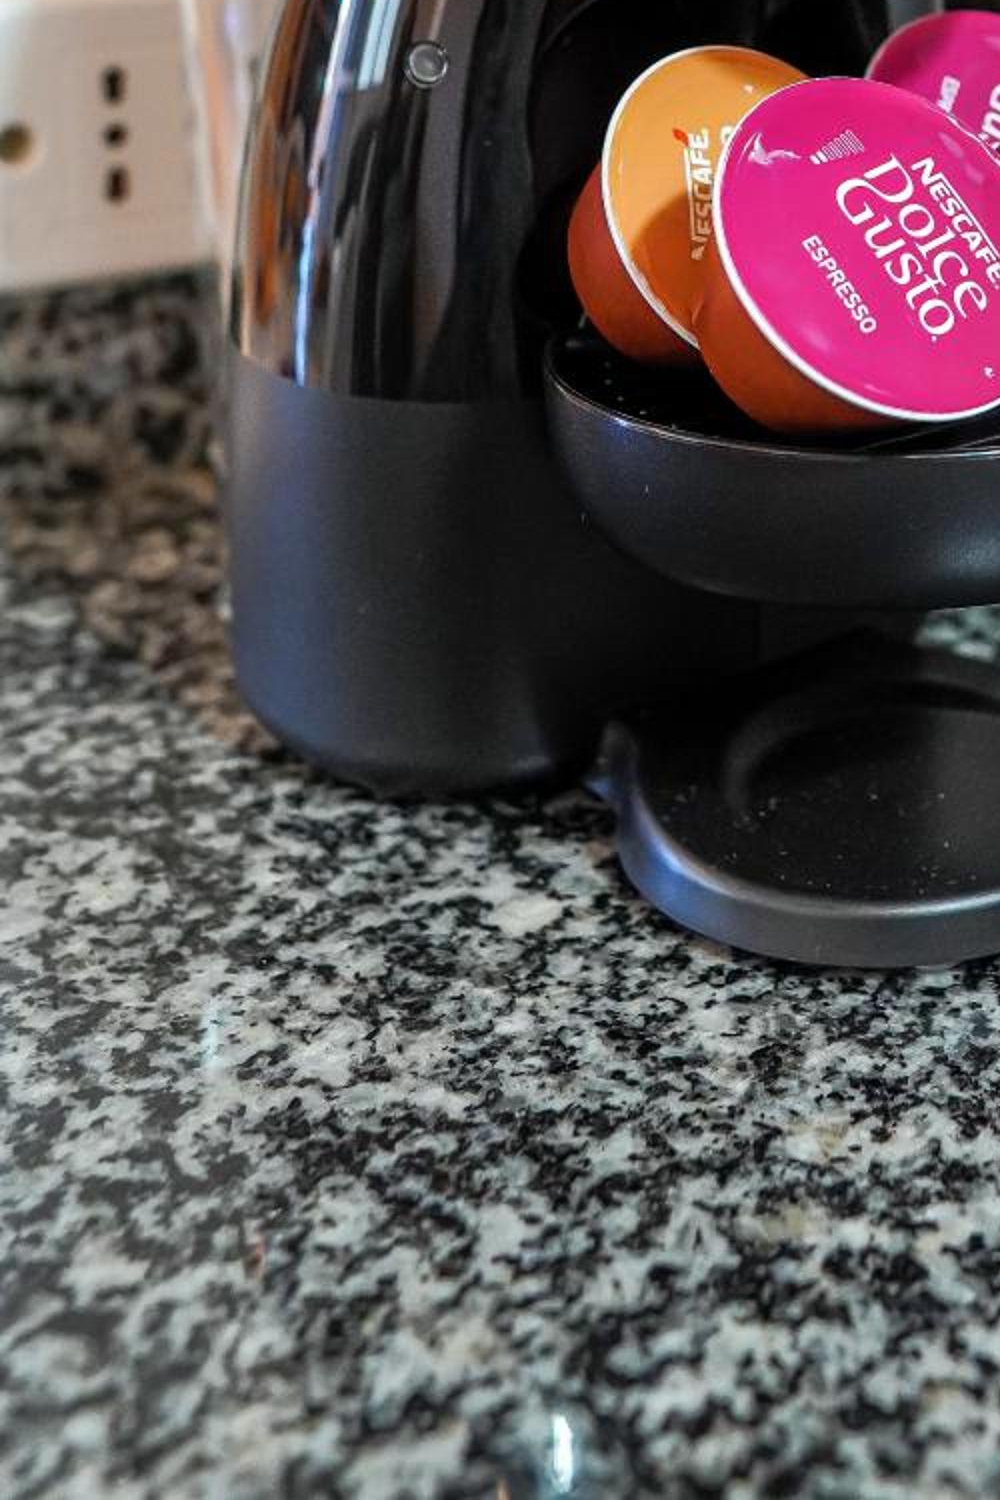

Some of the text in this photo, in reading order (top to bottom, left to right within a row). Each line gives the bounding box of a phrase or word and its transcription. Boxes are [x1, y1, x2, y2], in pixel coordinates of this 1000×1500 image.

[802, 234, 877, 334] ESPRESSO
[835, 177, 956, 336] Gusto
[863, 152, 988, 320] Dolce
